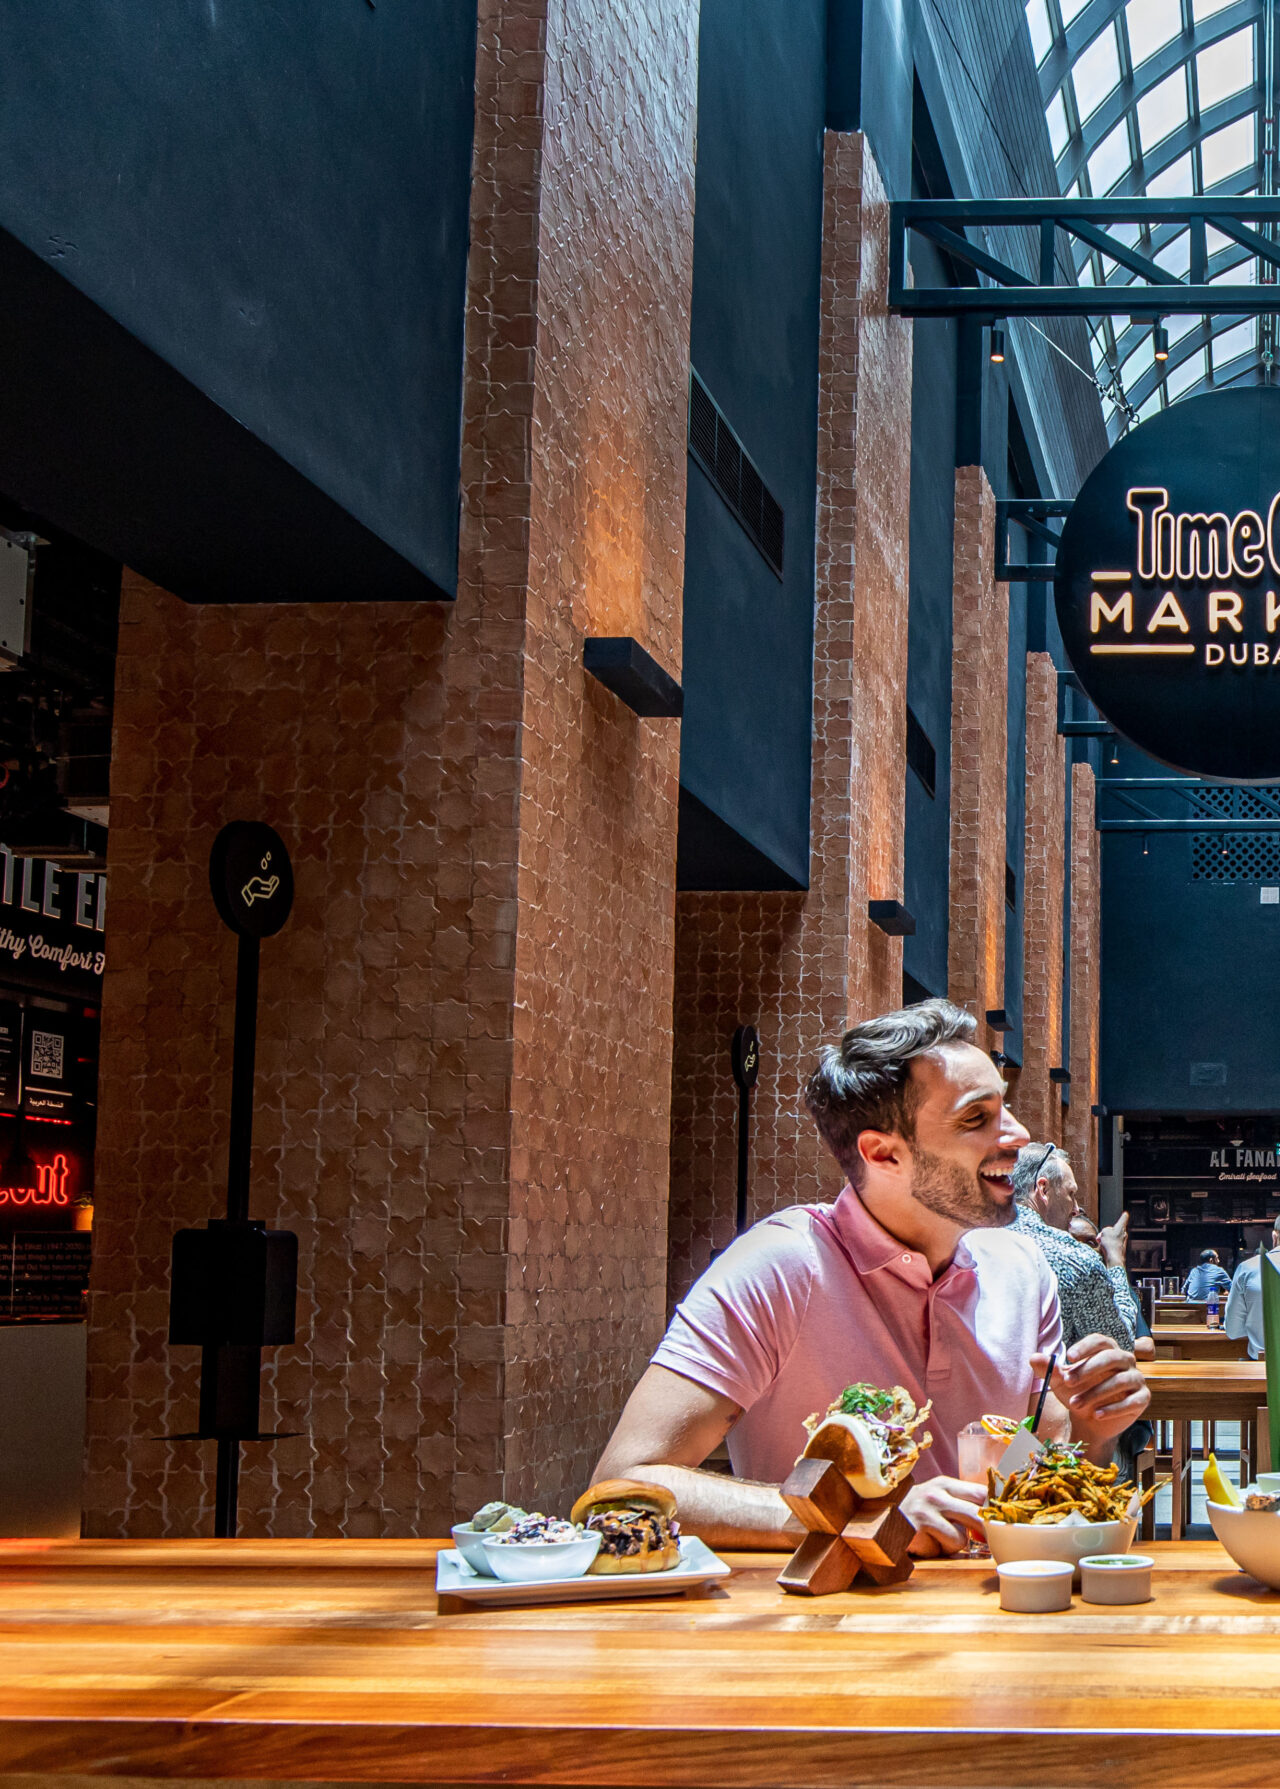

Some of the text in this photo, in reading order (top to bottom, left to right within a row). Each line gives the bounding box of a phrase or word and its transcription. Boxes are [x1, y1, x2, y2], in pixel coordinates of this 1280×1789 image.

[28, 934, 93, 971] Comfort
[1209, 1149, 1229, 1168] AL
[1218, 1171, 1277, 1182] Emirati Seafood
